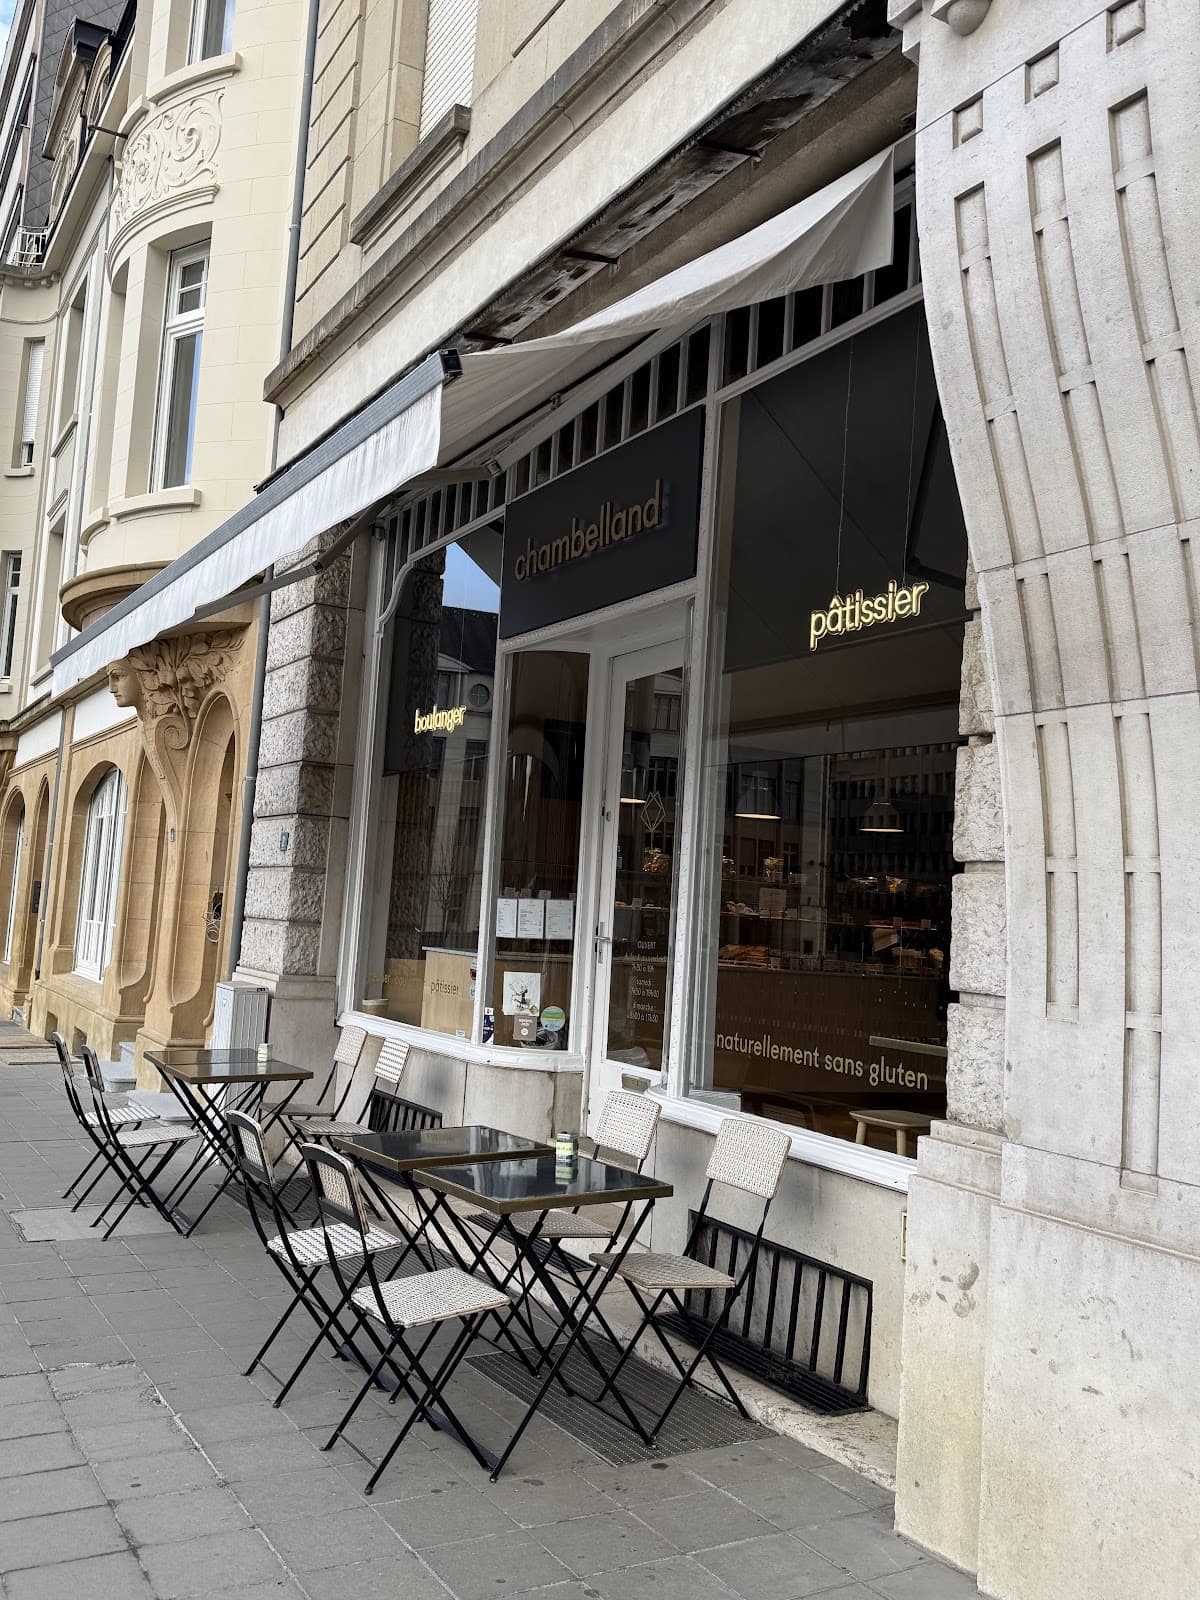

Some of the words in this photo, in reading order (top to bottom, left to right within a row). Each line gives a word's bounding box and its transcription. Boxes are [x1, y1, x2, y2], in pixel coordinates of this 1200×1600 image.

[515, 479, 661, 581] chambelland
[809, 580, 929, 652] pâtissier
[414, 704, 467, 735] boulanger
[716, 1032, 820, 1069] naturellement
[824, 1054, 864, 1078] sans
[869, 1056, 928, 1091] gluten
